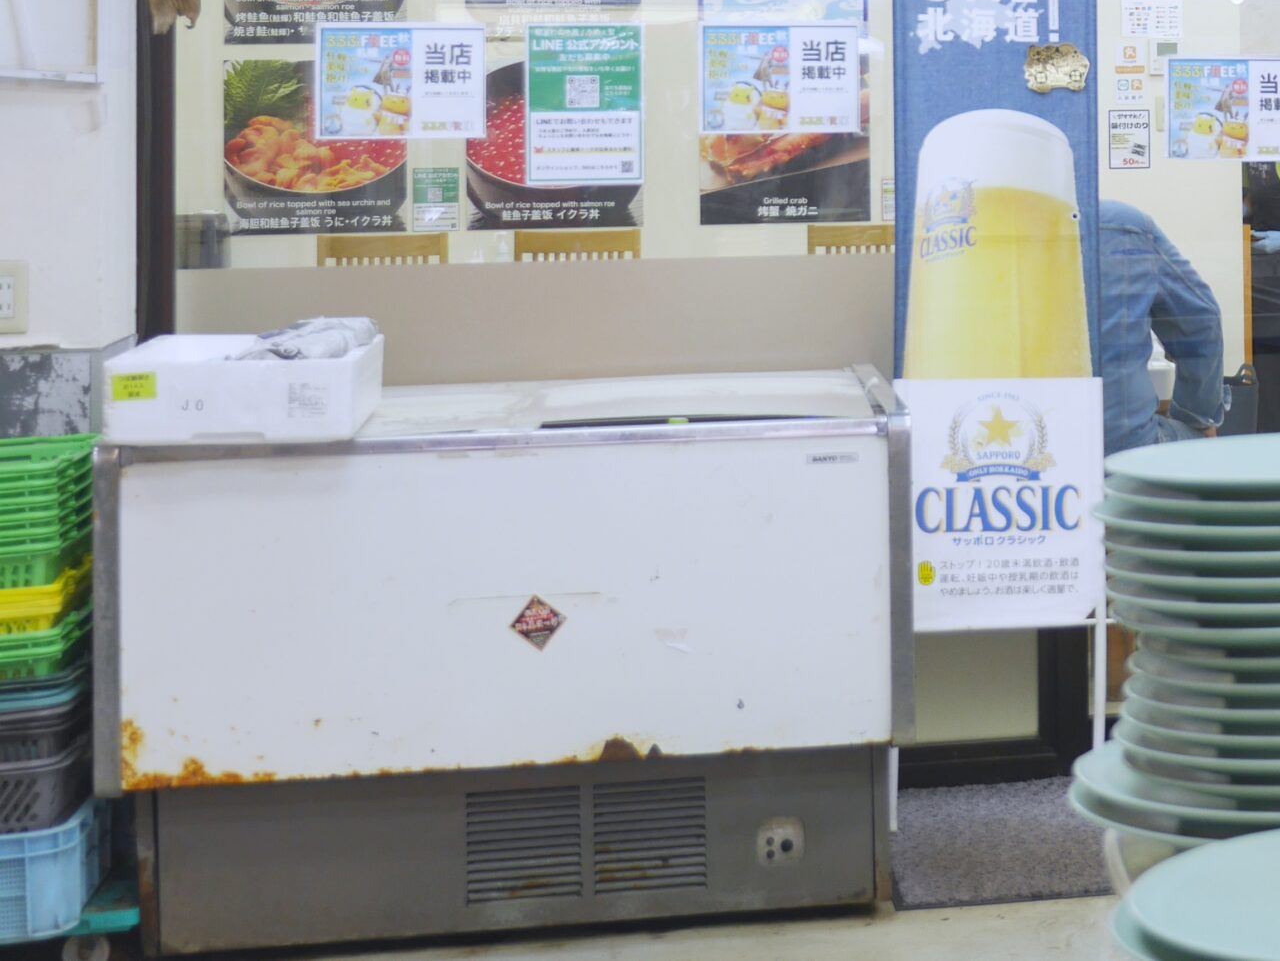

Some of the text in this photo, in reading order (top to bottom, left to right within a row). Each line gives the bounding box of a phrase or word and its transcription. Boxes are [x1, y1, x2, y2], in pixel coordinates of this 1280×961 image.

[532, 39, 563, 50] LINE
[425, 42, 473, 65] 当店
[801, 40, 847, 63] 当店
[424, 68, 473, 84] 掲載中
[801, 65, 847, 80] 掲載中
[236, 200, 257, 209] Bowl
[258, 200, 268, 208] of
[269, 200, 286, 208] rice
[287, 200, 317, 211] topped
[318, 199, 336, 207] with
[352, 199, 376, 207] urchin
[485, 201, 505, 209] Bowl
[505, 201, 514, 209] of
[516, 201, 532, 209] rice
[533, 201, 561, 210] topped
[763, 196, 808, 205] Grilled crab
[556, 209, 600, 221] イクラ丼
[977, 450, 1021, 460] SAPPORO
[988, 466, 1029, 476] HOKKAIDO
[914, 484, 1081, 534] CLASSIC
[952, 535, 1047, 547] サッポロクラシック
